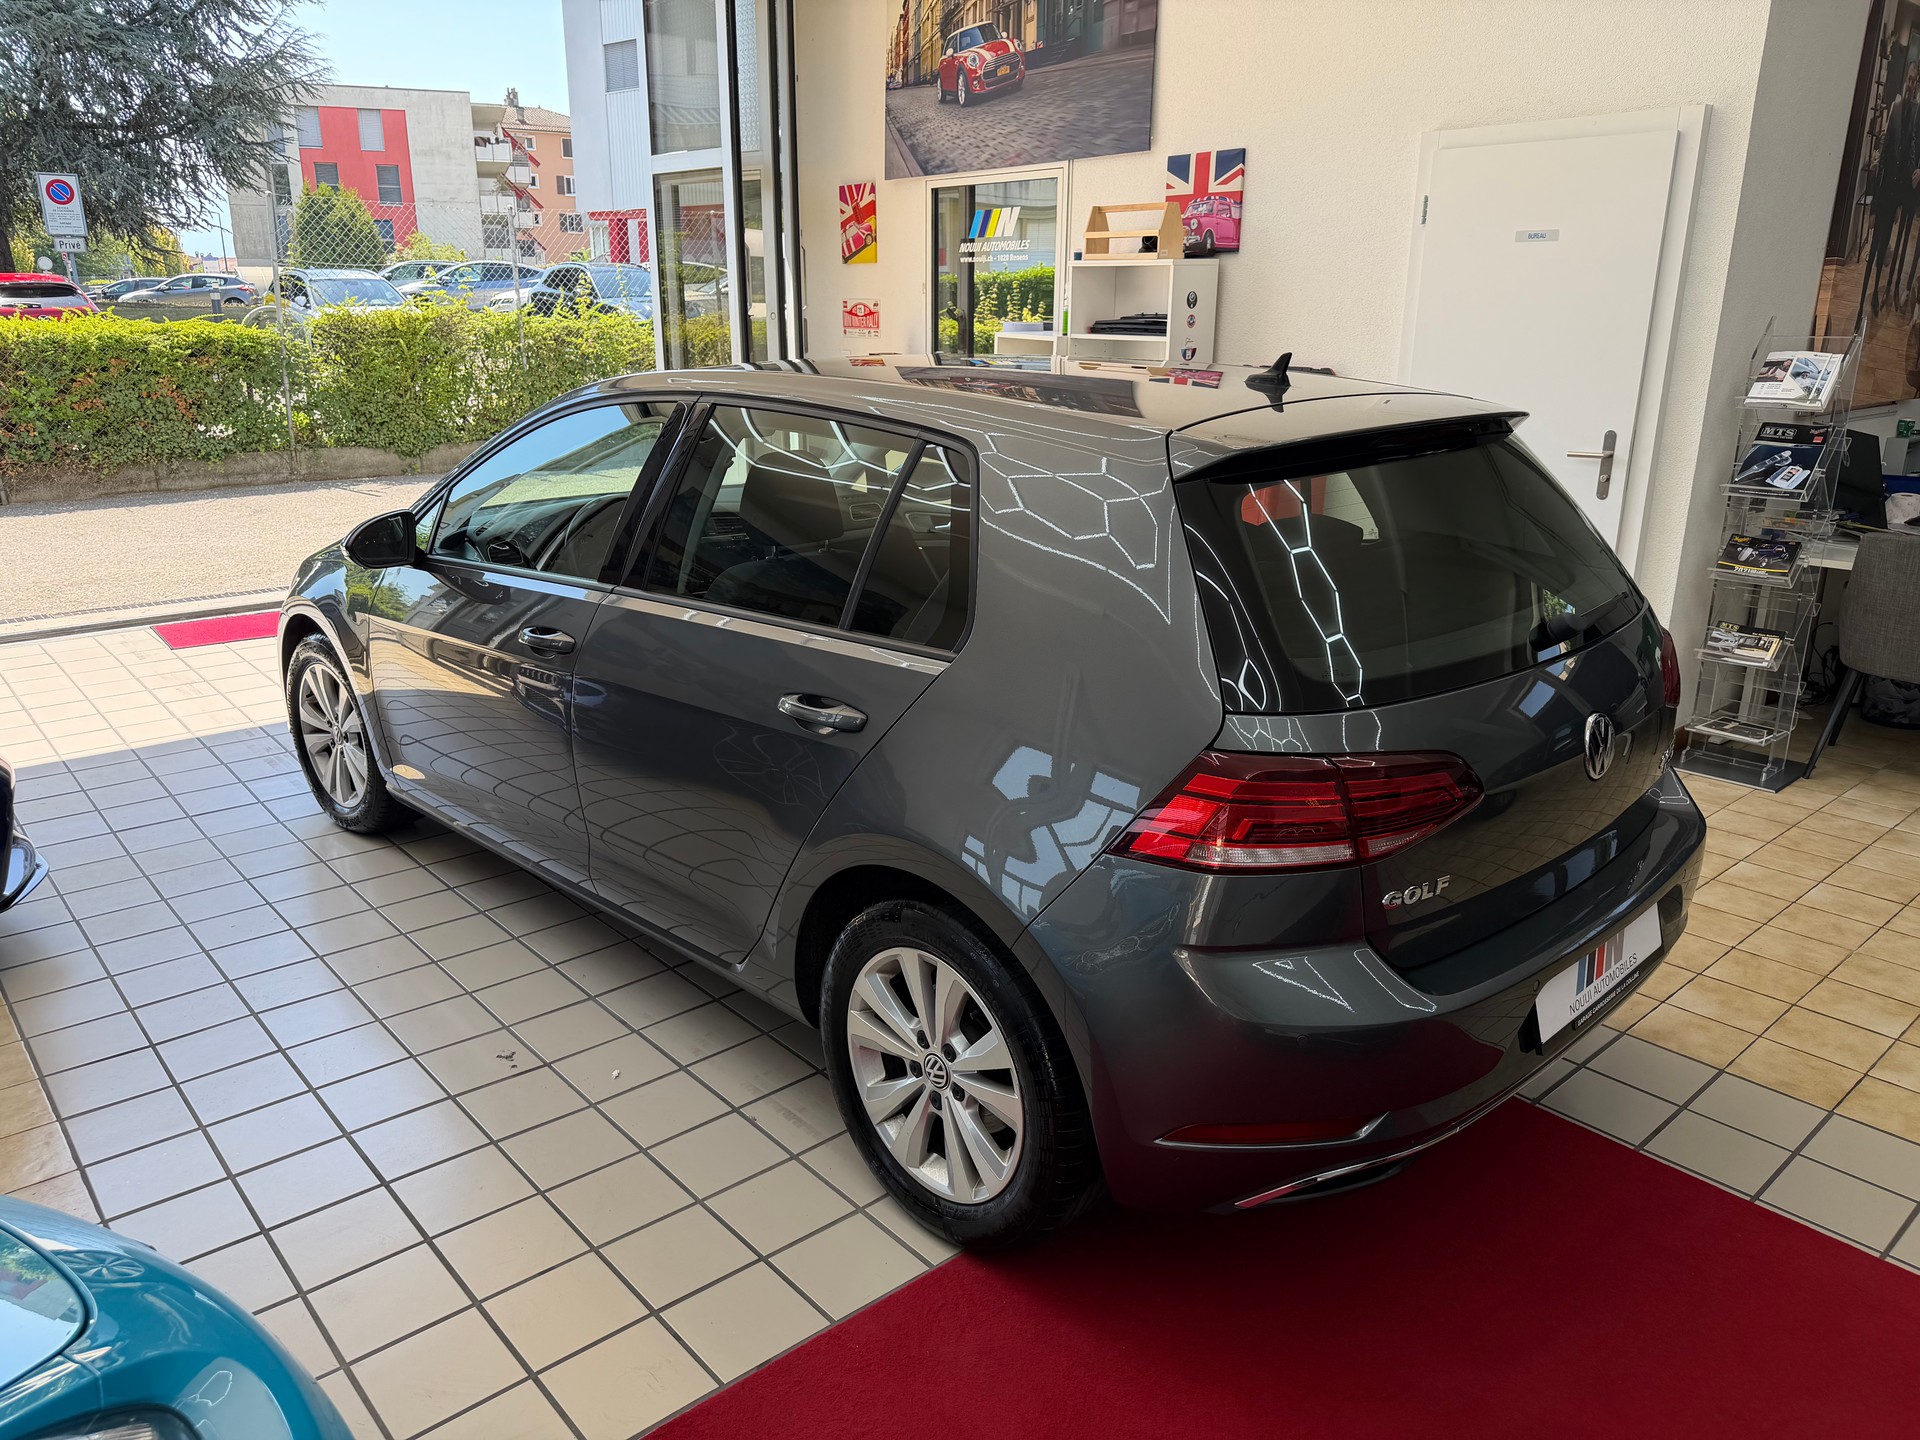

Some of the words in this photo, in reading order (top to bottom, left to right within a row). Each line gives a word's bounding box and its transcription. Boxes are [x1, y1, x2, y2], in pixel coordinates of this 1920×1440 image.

[59, 240, 81, 250] Privé
[981, 240, 1031, 252] AUTOMOBILES
[1763, 426, 1796, 437] MTS
[1381, 874, 1451, 910] GOLF
[1593, 953, 1638, 998] AUTOMOBILES
[1577, 1009, 1593, 1027] GARAGE
[1592, 992, 1616, 1014] CARROSSERIE
[1625, 970, 1640, 986] COLLINE
